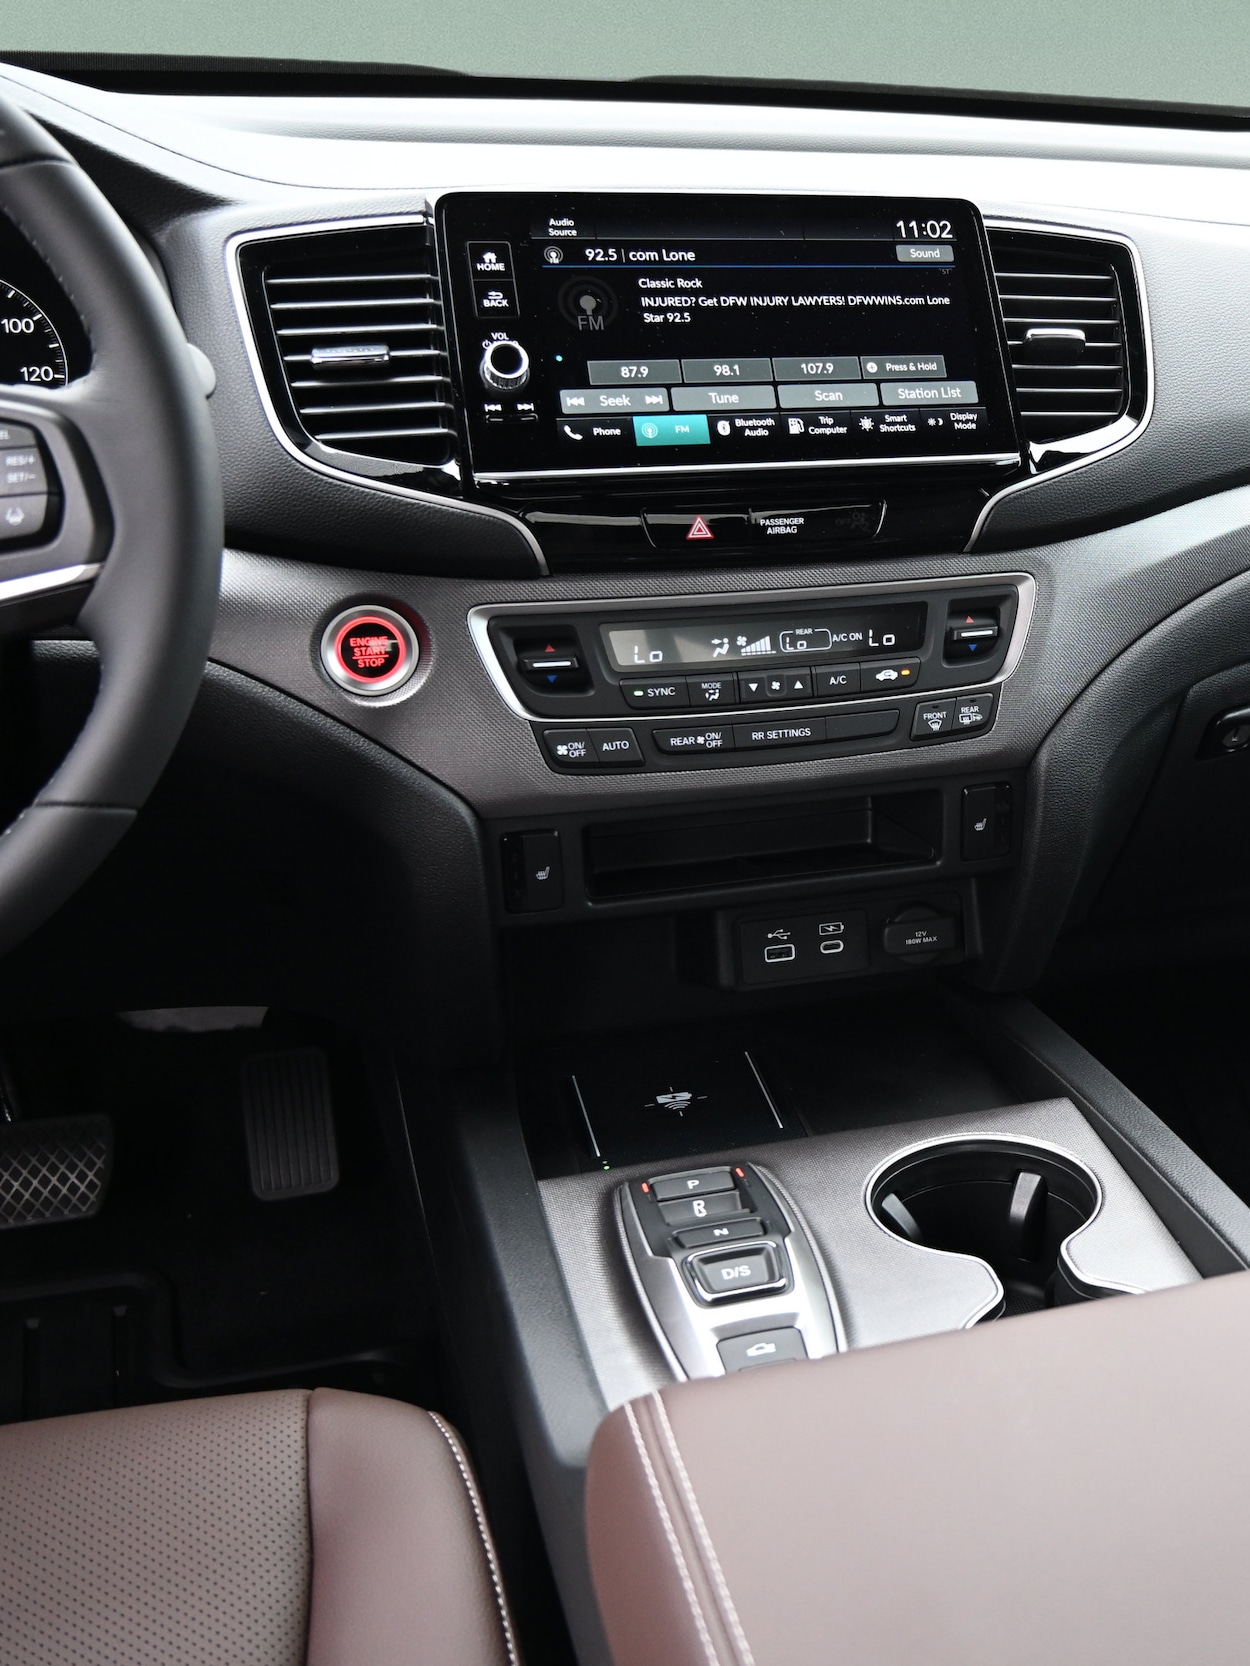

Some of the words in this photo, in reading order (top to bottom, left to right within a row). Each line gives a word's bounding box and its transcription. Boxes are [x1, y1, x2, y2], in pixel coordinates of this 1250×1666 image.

[549, 218, 575, 228] Audio
[548, 228, 578, 237] Source
[896, 219, 953, 239] 11:02
[585, 248, 618, 262] 92.5
[629, 250, 659, 262] com
[662, 248, 696, 262] Lone
[910, 248, 940, 259] Sound
[476, 263, 506, 272] HOME
[638, 277, 675, 289] Classic
[677, 277, 703, 289] Rock
[483, 298, 509, 308] BACK
[641, 296, 696, 307] INJURED?
[699, 296, 718, 307] Get
[720, 296, 748, 307] DFW
[750, 295, 789, 307] INJURY
[791, 295, 846, 306] LAWYERS!
[847, 295, 925, 306] DFWWINS.com
[927, 295, 951, 306] Lone
[643, 312, 665, 323] Star
[667, 312, 691, 323] 92.5
[1, 318, 34, 334] 100
[577, 316, 605, 331] FM
[491, 332, 509, 341] VOL
[620, 366, 649, 378] 87.9
[713, 364, 740, 376] 98.1
[800, 362, 834, 375] 107.9
[886, 362, 908, 372] Press
[909, 362, 917, 371] &
[918, 361, 937, 371] Hold
[20, 366, 53, 382] 120
[708, 392, 739, 404] Tune
[814, 390, 843, 402] Scan
[898, 387, 940, 399] Station
[942, 387, 962, 398] List
[600, 396, 631, 407] Seek
[735, 417, 775, 427] Bluetooth
[818, 416, 834, 426] Trip
[884, 413, 907, 423] Smart
[950, 411, 978, 422] Display
[675, 425, 690, 434] FM
[808, 424, 848, 436] Computer
[879, 422, 916, 433] Shortcuts
[954, 420, 977, 430] Mode
[593, 427, 621, 436] Phone
[744, 426, 769, 437] Audio
[760, 517, 805, 527] PASSENGER
[766, 526, 798, 535] AIRBAG
[796, 627, 813, 636] REAR
[832, 632, 848, 643] A/C
[849, 631, 863, 641] ON
[349, 636, 388, 646] ENGINE
[354, 647, 386, 656] START
[358, 658, 385, 668] STOP
[829, 674, 848, 686] A/C
[701, 682, 722, 690] MODE
[647, 686, 676, 698] SYNC
[961, 705, 980, 714] REAR
[923, 711, 947, 720] FRONT
[670, 735, 695, 747] REAR
[705, 732, 722, 742] ON/
[752, 730, 765, 741] RR
[767, 727, 812, 740] SETTINGS
[567, 742, 586, 752] ON/
[602, 740, 630, 751] AUTO
[706, 739, 723, 749] OFF
[569, 749, 587, 758] OFF
[687, 1179, 700, 1190] P
[693, 1200, 707, 1217] R
[713, 1227, 729, 1236] N
[721, 1265, 751, 1280] D/S
